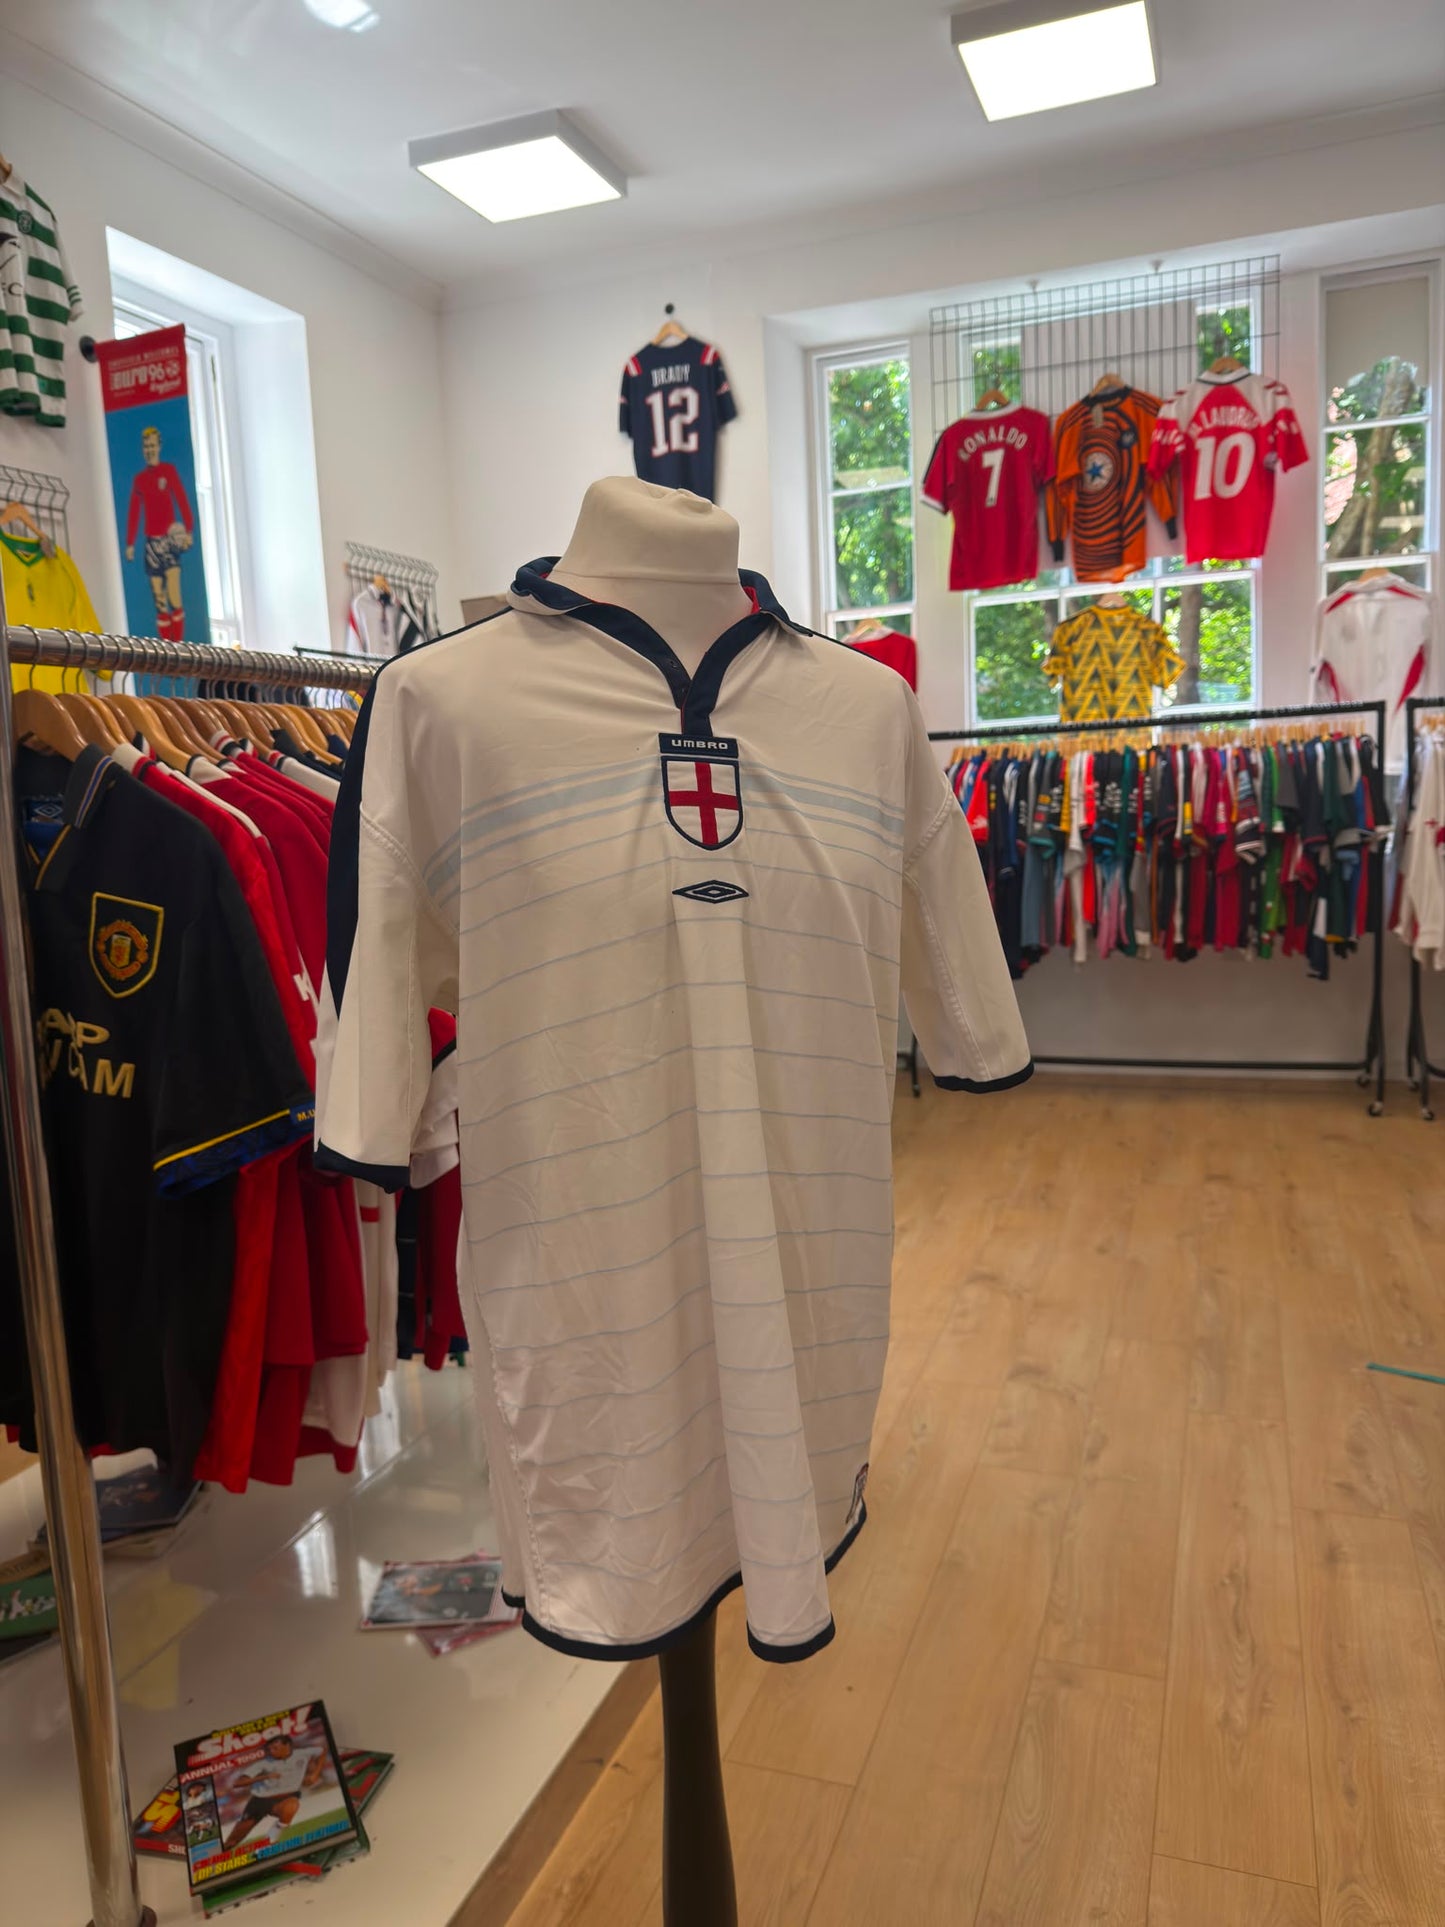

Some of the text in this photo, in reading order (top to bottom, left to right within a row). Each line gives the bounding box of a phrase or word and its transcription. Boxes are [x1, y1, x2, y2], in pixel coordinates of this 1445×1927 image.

[651, 364, 690, 387] BRADY
[645, 386, 699, 458] 12
[982, 448, 1005, 508] 7
[1194, 431, 1256, 501] 10
[671, 739, 728, 750] UMBRO
[190, 1704, 313, 1763] Shoot!
[181, 1760, 234, 1783] ANNUAL
